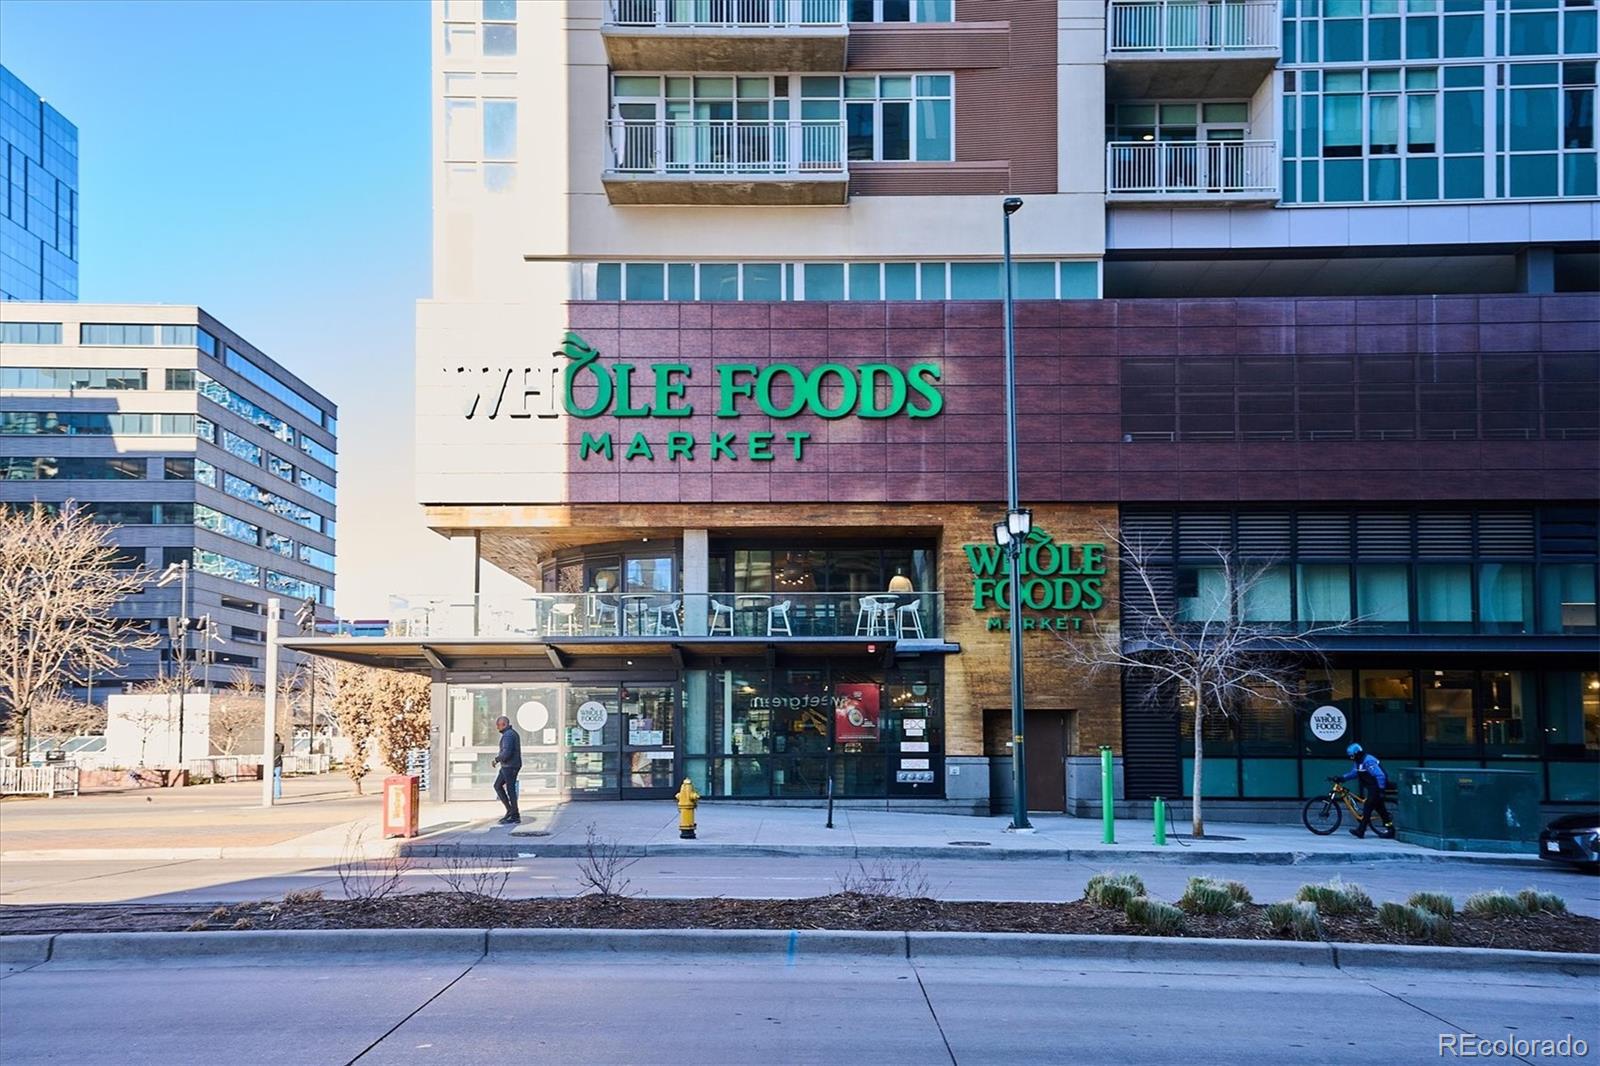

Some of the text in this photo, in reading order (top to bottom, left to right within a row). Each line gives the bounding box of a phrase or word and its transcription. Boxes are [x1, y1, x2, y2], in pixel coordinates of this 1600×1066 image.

[441, 362, 944, 420] WHOLE FOODS
[580, 432, 812, 461] MARKET
[963, 542, 1107, 576] WHOLE
[972, 577, 1103, 611] FOODS
[987, 616, 1083, 631] MRKET
[1314, 715, 1342, 723] WHOLE
